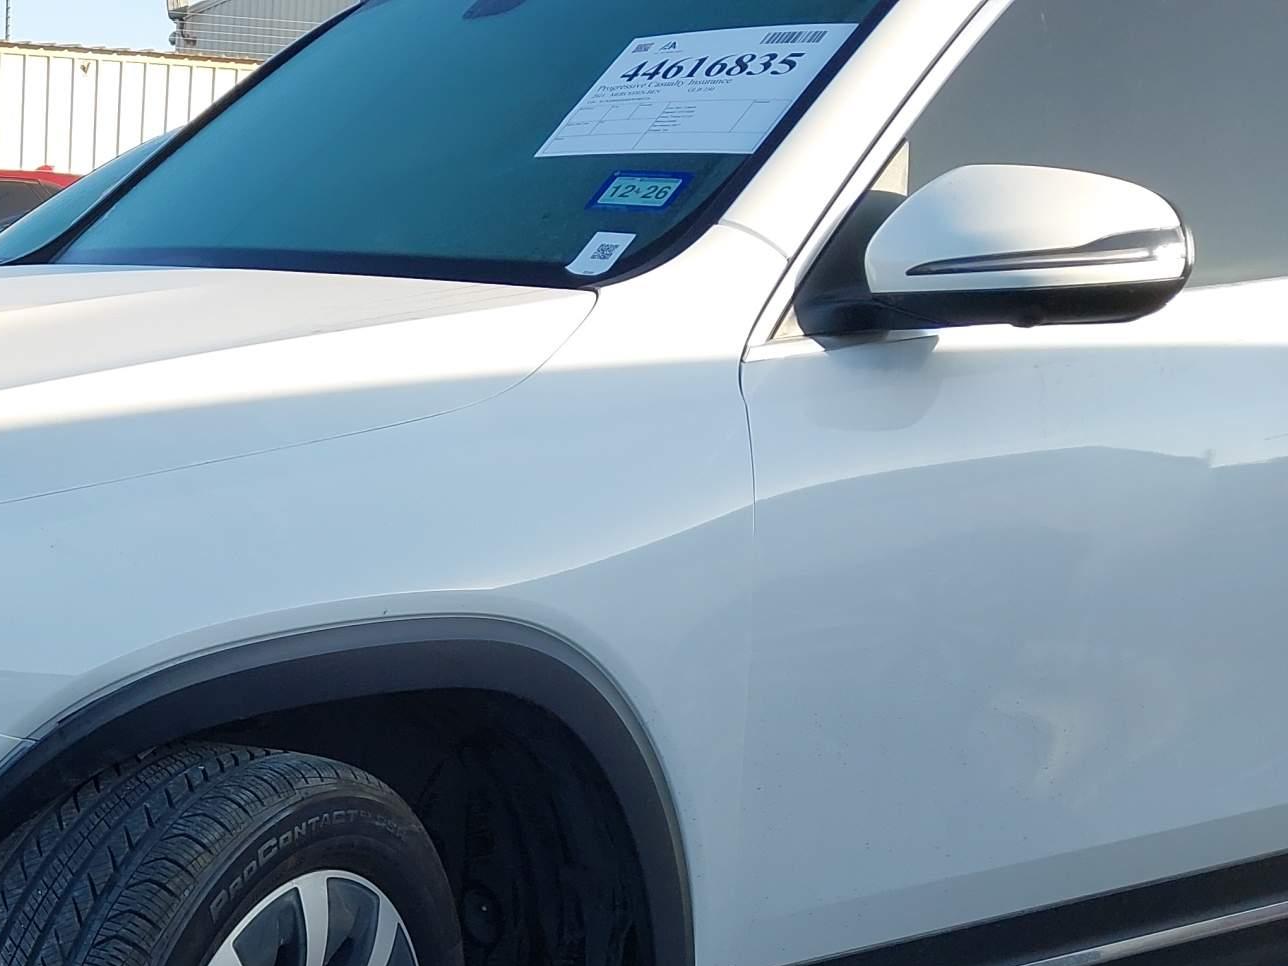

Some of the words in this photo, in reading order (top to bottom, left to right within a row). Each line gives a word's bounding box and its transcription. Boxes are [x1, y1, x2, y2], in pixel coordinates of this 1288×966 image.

[620, 52, 805, 82] 44616835
[597, 83, 647, 92] Progressive
[648, 79, 684, 88] Casualty
[687, 77, 733, 86] Insurance
[640, 185, 672, 199] 26
